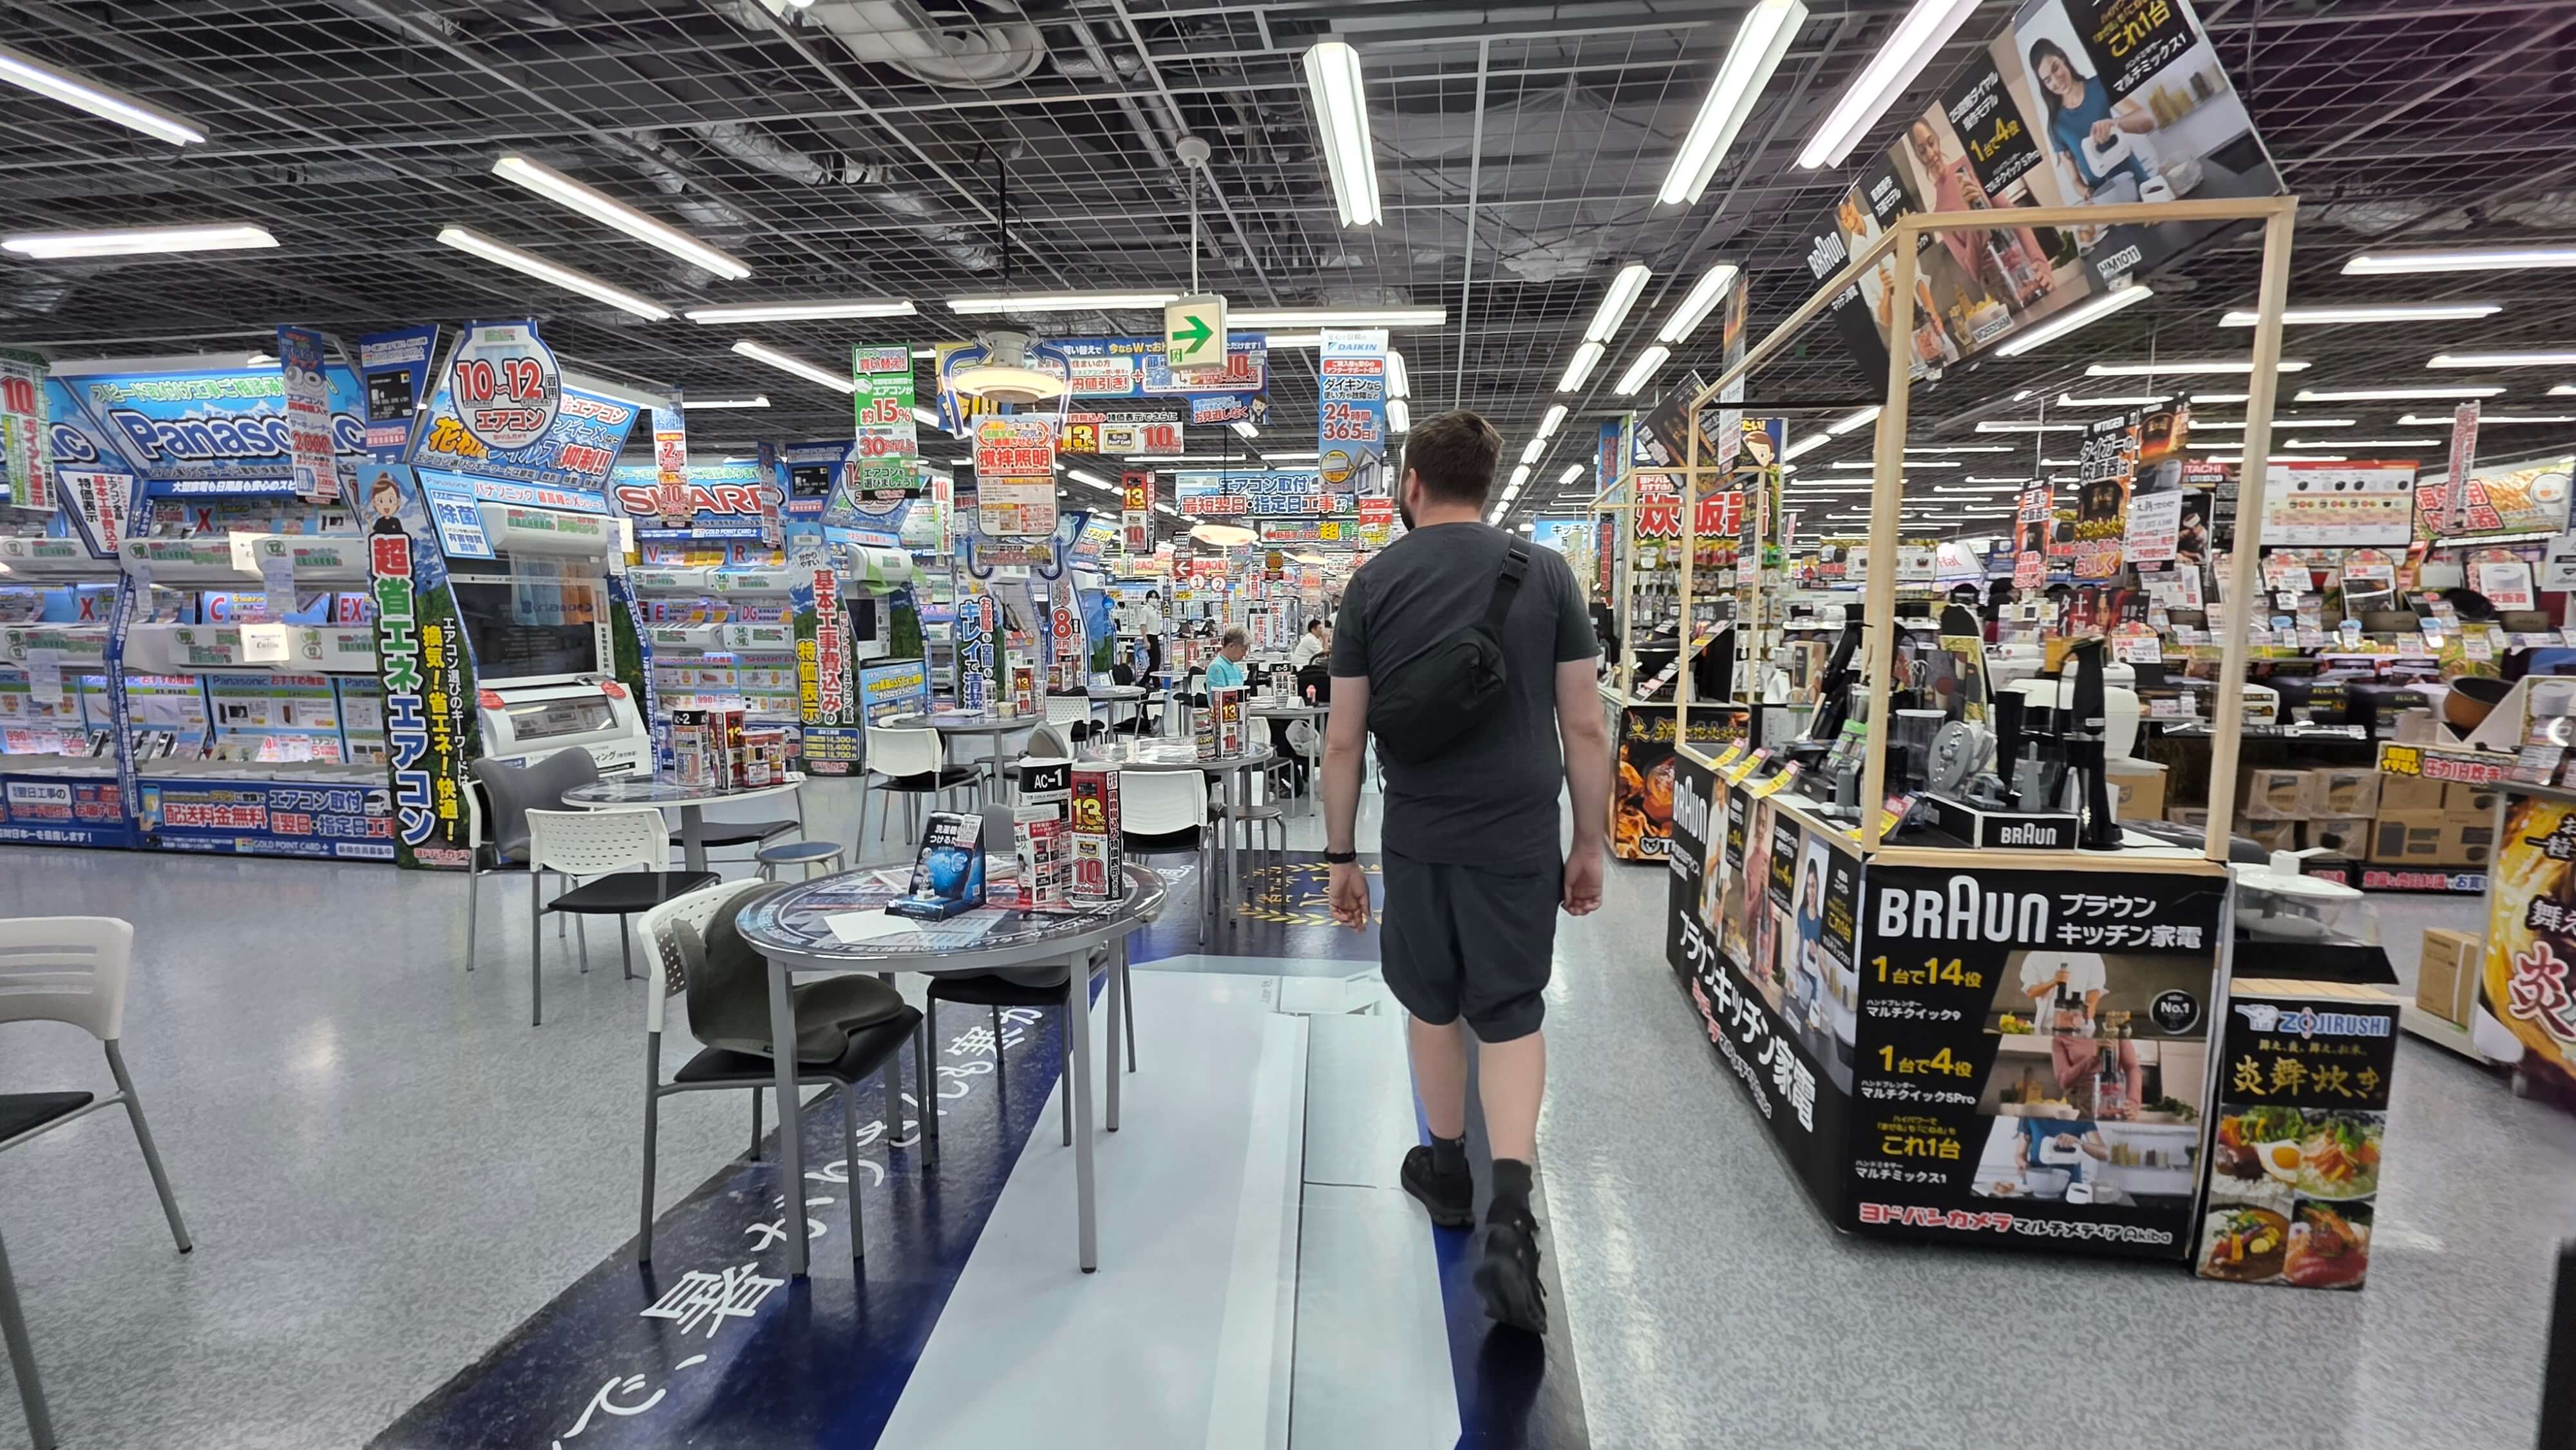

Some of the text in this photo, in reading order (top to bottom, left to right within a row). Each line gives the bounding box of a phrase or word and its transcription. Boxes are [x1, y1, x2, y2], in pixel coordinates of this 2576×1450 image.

[2113, 31, 2187, 91] マルチミックス1
[1970, 117, 2021, 162] 1台で4役
[1807, 231, 1847, 279] BRAUN
[1323, 377, 1382, 391] ダイキンなら
[476, 408, 546, 433] エアコン
[1323, 403, 1371, 422] 24時間
[109, 409, 365, 462] Panasoc
[2183, 464, 2223, 474] ITACHI
[474, 484, 534, 502] パナソニック
[1218, 475, 1310, 494] エアコン取付
[1180, 495, 1336, 515] 最短翌日・指定日工事
[1359, 499, 1392, 509] シャープ
[209, 596, 225, 622] C
[339, 597, 364, 623] EX
[212, 675, 269, 686] Panasonic
[368, 531, 437, 847] 超省エネエアコン
[1034, 768, 1063, 789] AC-1
[269, 789, 362, 813] エアコン取付
[1672, 775, 1708, 845] BRAUN
[164, 803, 268, 829] 配送料金無料
[252, 840, 320, 852] GOLD POINT CARD
[2000, 822, 2058, 846] BRAUN
[1877, 874, 2049, 945] BRAUN
[2060, 894, 2157, 919] ブラウン
[2056, 923, 2204, 951] キッチン家電
[1871, 955, 1983, 989] 1台で14役
[1866, 1006, 1962, 1022] マルチクイック9
[2160, 1001, 2190, 1014] No.1
[2278, 1006, 2392, 1039] ZOJIRUSHI
[1878, 1044, 1973, 1078] 1台で4役
[2233, 1053, 2381, 1099] 炎舞炊き
[1861, 1086, 1976, 1106] マルチクイック5Pro
[1881, 1135, 1962, 1160] これ1台
[1855, 1166, 1947, 1184] マルチミックス1
[1860, 1203, 2012, 1232] ヨドバシカメラ
[2121, 1226, 2174, 1245] Akiba
